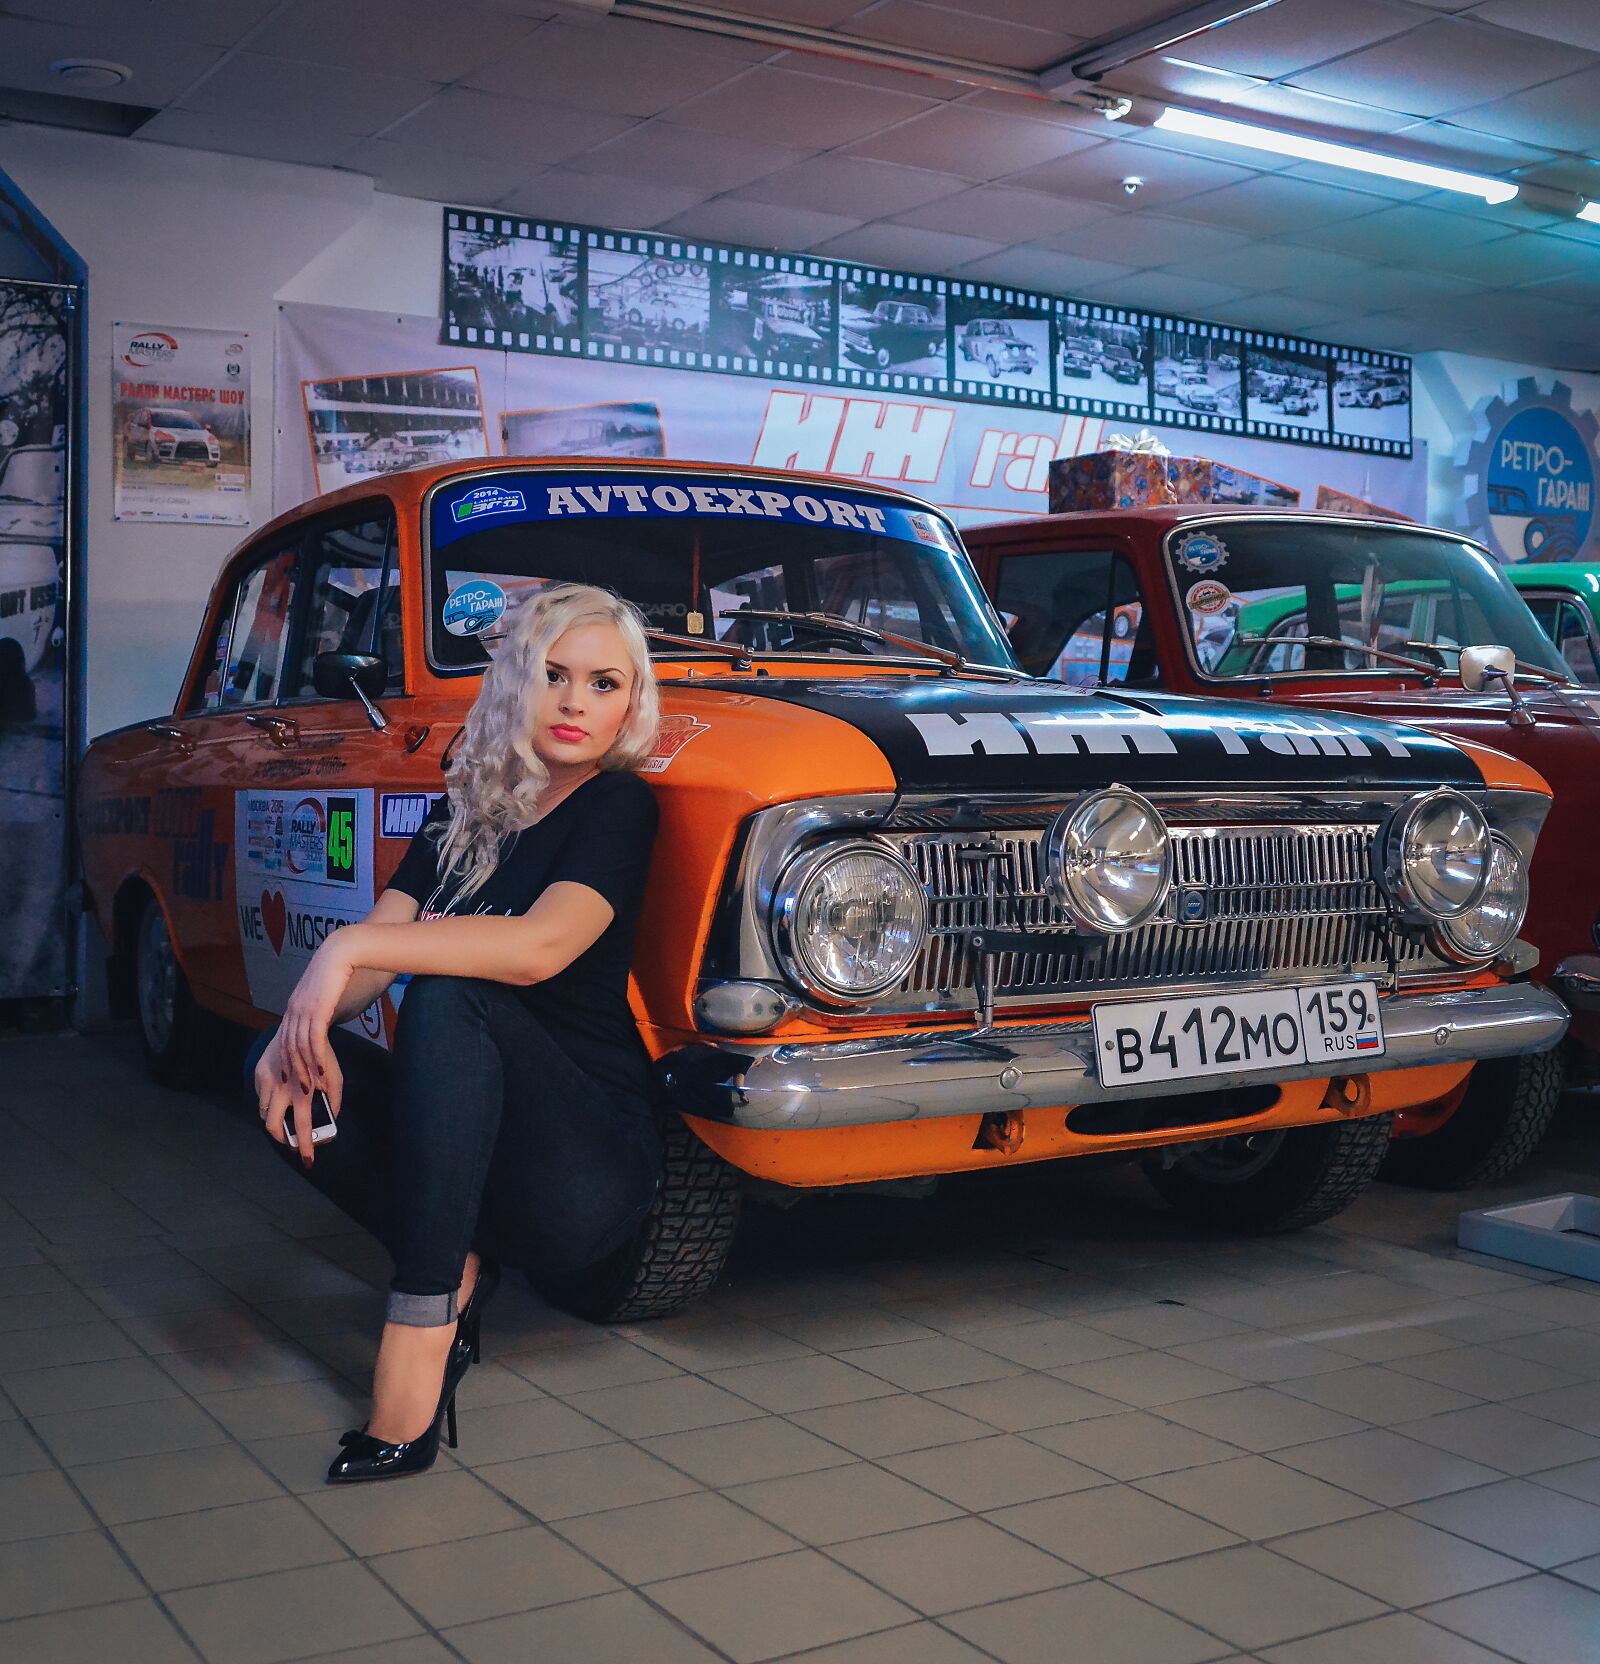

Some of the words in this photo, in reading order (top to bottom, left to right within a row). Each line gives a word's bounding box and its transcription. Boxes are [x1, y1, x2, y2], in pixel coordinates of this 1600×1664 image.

[130, 341, 165, 350] RALLY
[120, 383, 160, 399] РАЛЛИ
[163, 385, 216, 403] МАСТЕРС
[219, 390, 245, 405] ШОУ
[751, 389, 956, 483] ИЖ
[969, 414, 1106, 494] rall
[1501, 439, 1573, 475] РЕТРО-
[473, 489, 499, 499] 2014
[1537, 477, 1590, 512] ГАРАЖ
[546, 485, 887, 533] AVTOEXPORT
[450, 590, 491, 609] РЕТРО-
[470, 598, 503, 613] ГАРАЖ
[291, 819, 317, 834] RALLY
[385, 798, 425, 833] ИЖ
[289, 834, 325, 851] MASTERS
[328, 810, 353, 870] 45
[240, 905, 264, 941] WE
[1306, 988, 1368, 1035] 159
[1324, 1034, 1356, 1052] RUS
